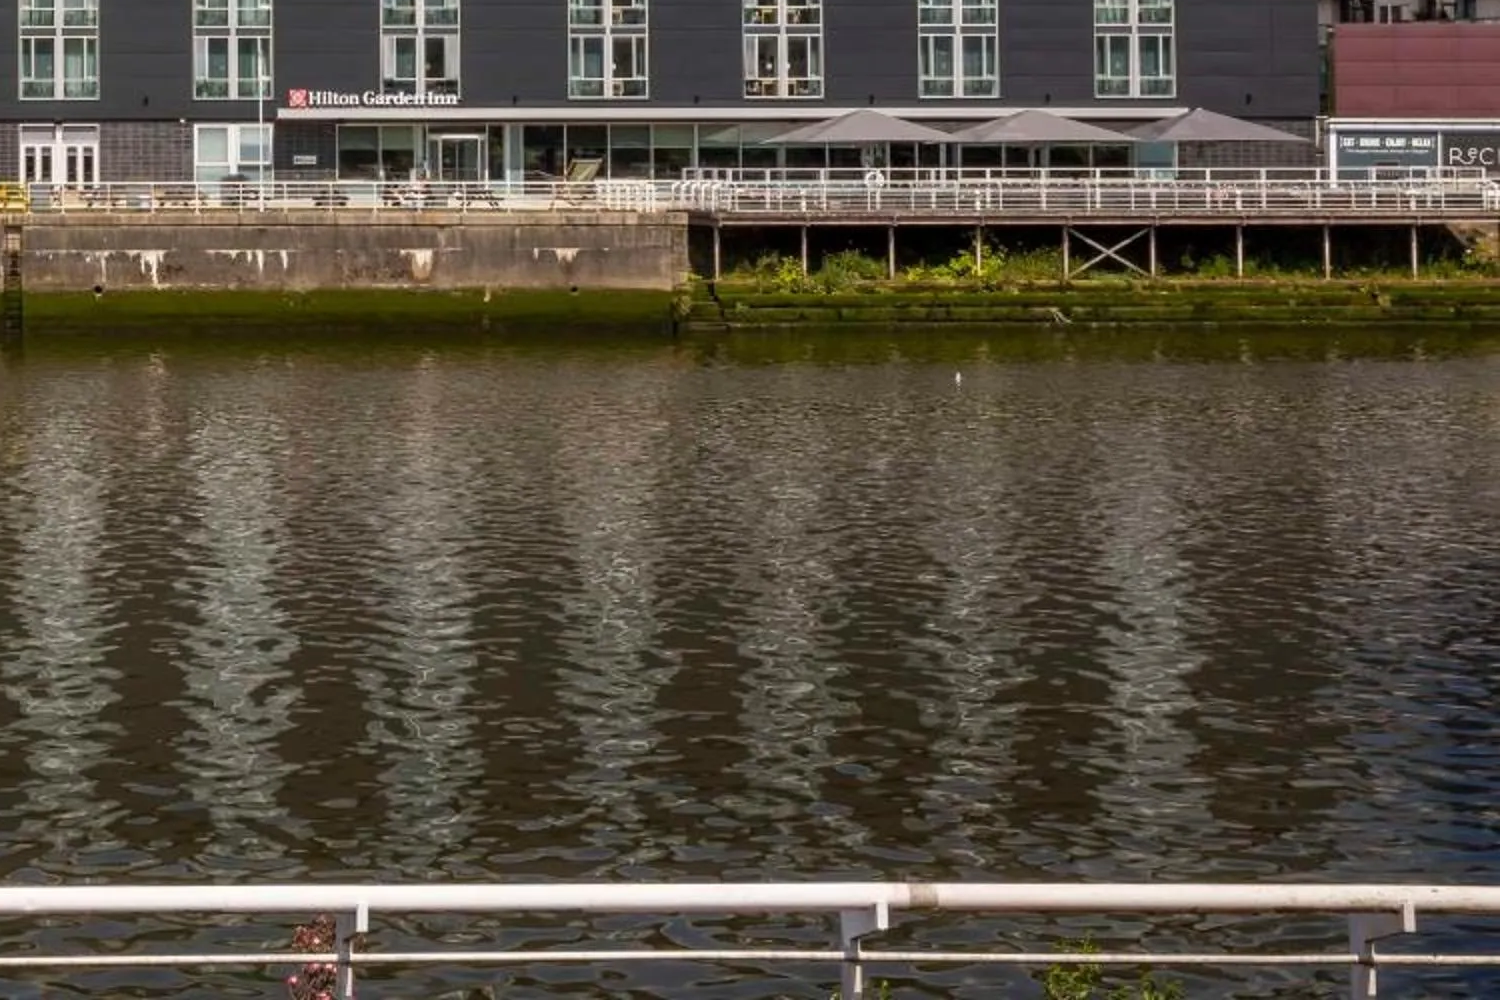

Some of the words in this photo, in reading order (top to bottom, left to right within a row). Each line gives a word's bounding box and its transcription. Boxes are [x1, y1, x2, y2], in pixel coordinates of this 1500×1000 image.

[308, 90, 360, 105] Hilton
[362, 90, 426, 105] Garden
[428, 90, 458, 105] Inn
